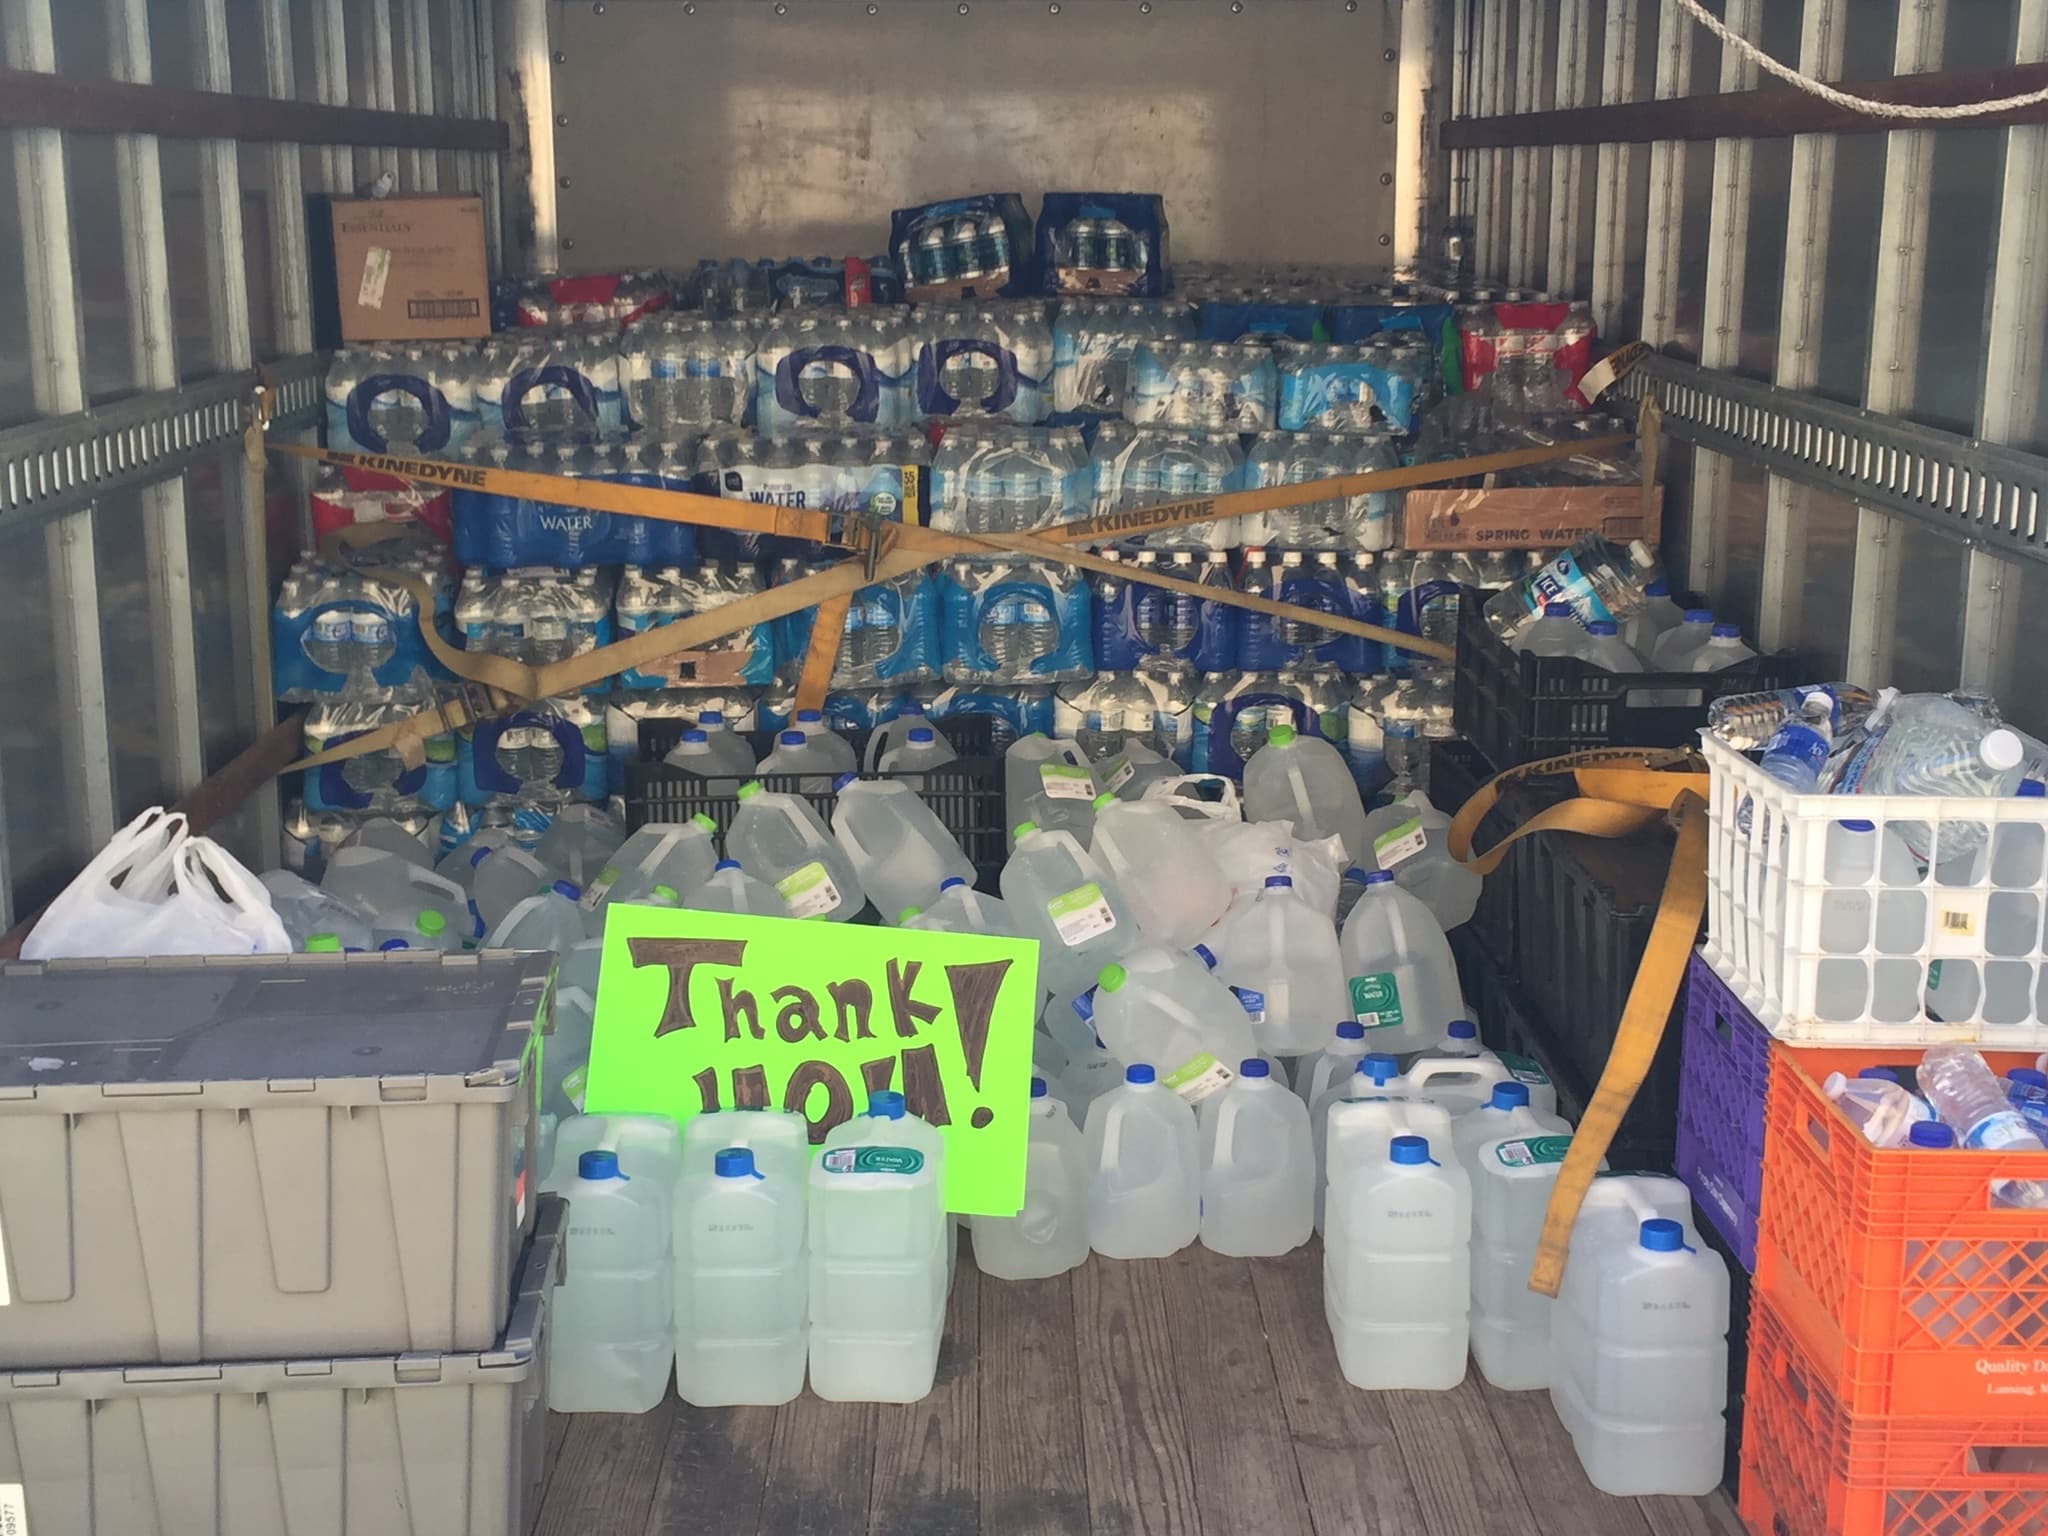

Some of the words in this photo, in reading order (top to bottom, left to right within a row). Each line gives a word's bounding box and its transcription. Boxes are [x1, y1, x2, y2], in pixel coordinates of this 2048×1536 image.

[359, 455, 488, 487] KINEDYNE
[540, 515, 593, 532] WATER
[1097, 500, 1216, 533] KINEDYNE
[1475, 528, 1530, 542] SPRING
[1540, 576, 1558, 596] ICE
[626, 936, 943, 1043] Thank
[1975, 1359, 2028, 1376] Quality
